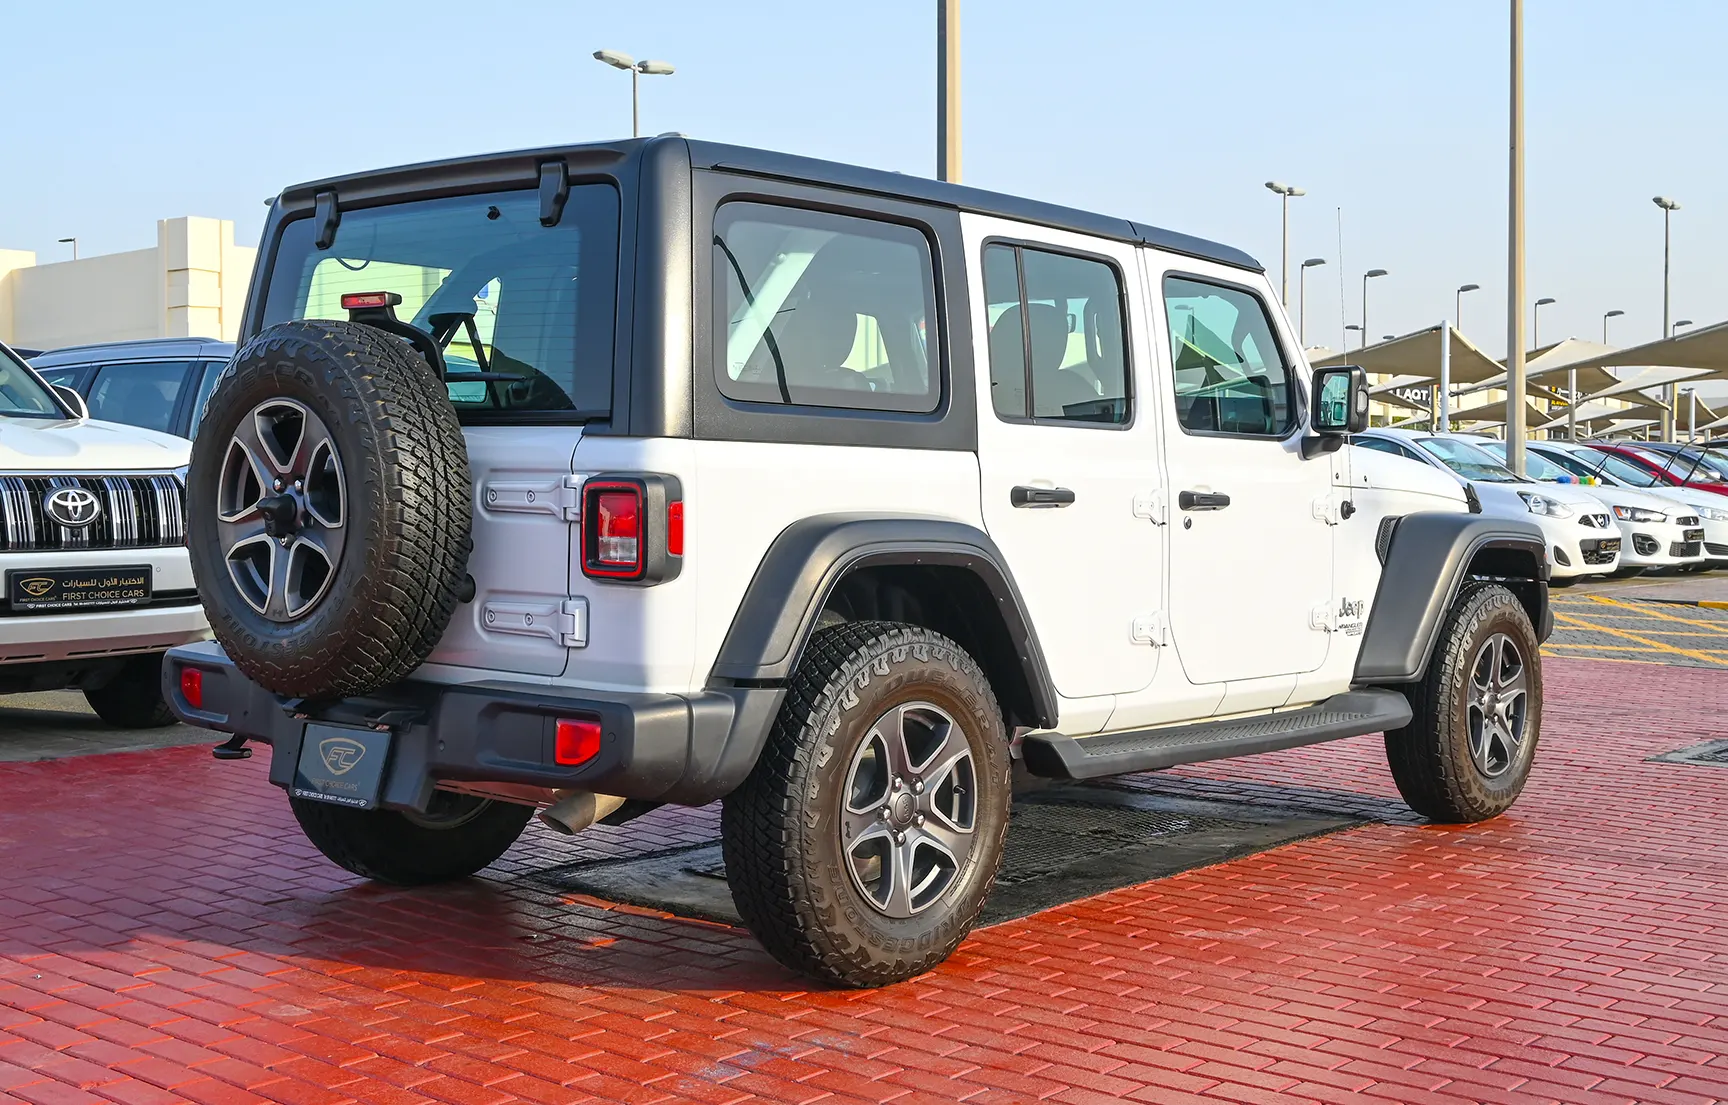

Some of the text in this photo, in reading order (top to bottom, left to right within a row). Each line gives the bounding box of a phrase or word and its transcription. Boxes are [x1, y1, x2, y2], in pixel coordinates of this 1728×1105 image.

[62, 589, 145, 600] FIRST CHOICE CARS
[1339, 597, 1364, 619] Jeep
[884, 669, 990, 732] DUELER
[827, 864, 972, 954] BRIDGESTONE
